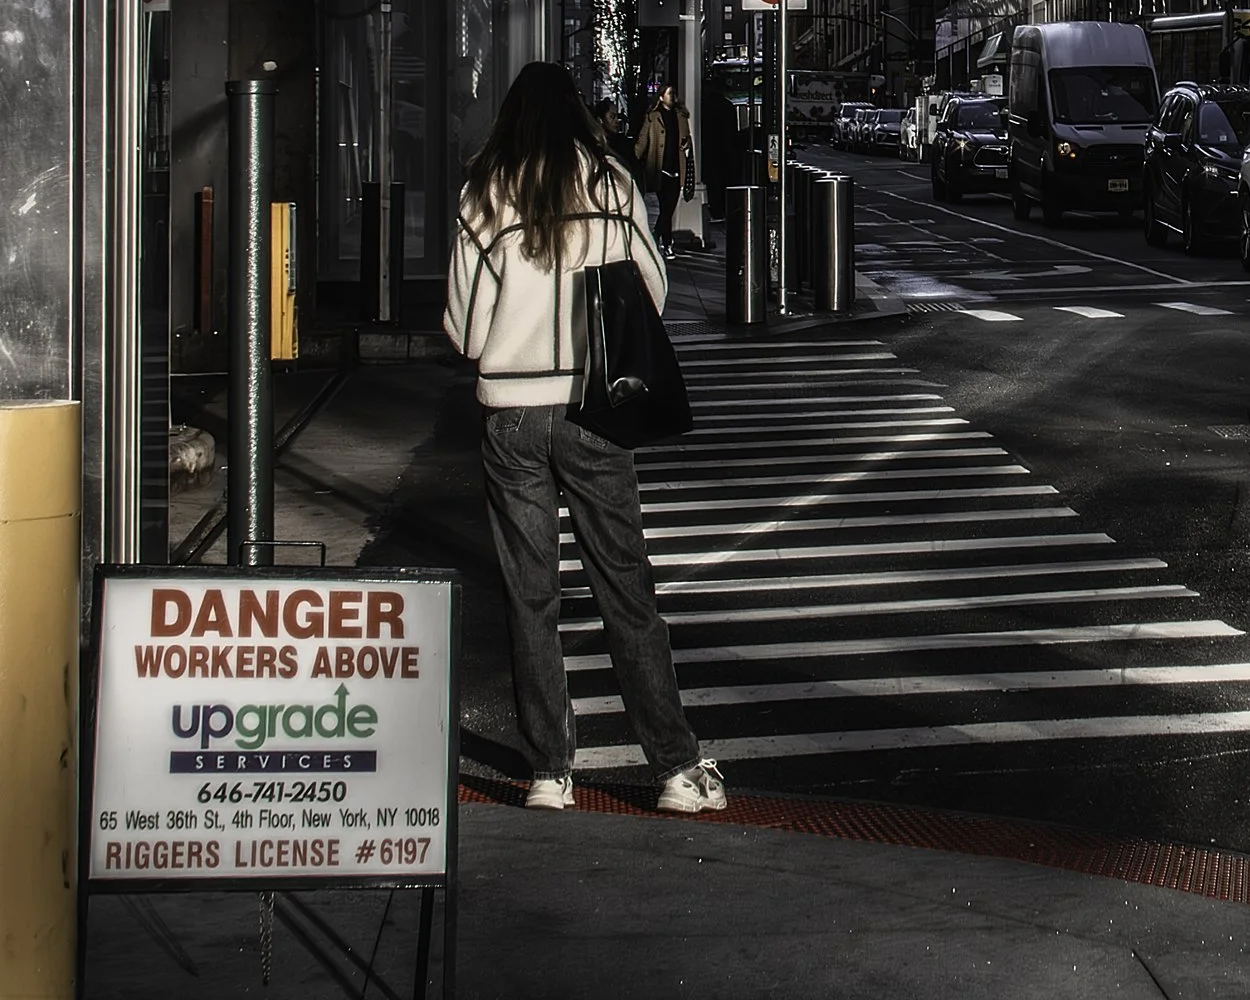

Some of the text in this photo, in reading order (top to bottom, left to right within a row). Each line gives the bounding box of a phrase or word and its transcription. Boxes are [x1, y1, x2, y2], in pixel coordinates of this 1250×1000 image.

[150, 589, 405, 639] DANGER
[135, 645, 420, 679] WORKERS ABOVE
[172, 684, 378, 750] upgrade
[195, 754, 354, 770] SERVICES
[197, 781, 347, 804] 646-741-2450
[100, 810, 118, 830] 65
[125, 809, 160, 830] West
[166, 809, 198, 829] 36th
[232, 809, 254, 829] 4th
[258, 809, 296, 832] Floor,
[301, 809, 331, 829] New
[339, 809, 371, 831] York,
[376, 808, 398, 828] NY
[405, 807, 440, 827] 10018
[105, 840, 220, 870] RIGGERS
[235, 839, 340, 868] LICENSE
